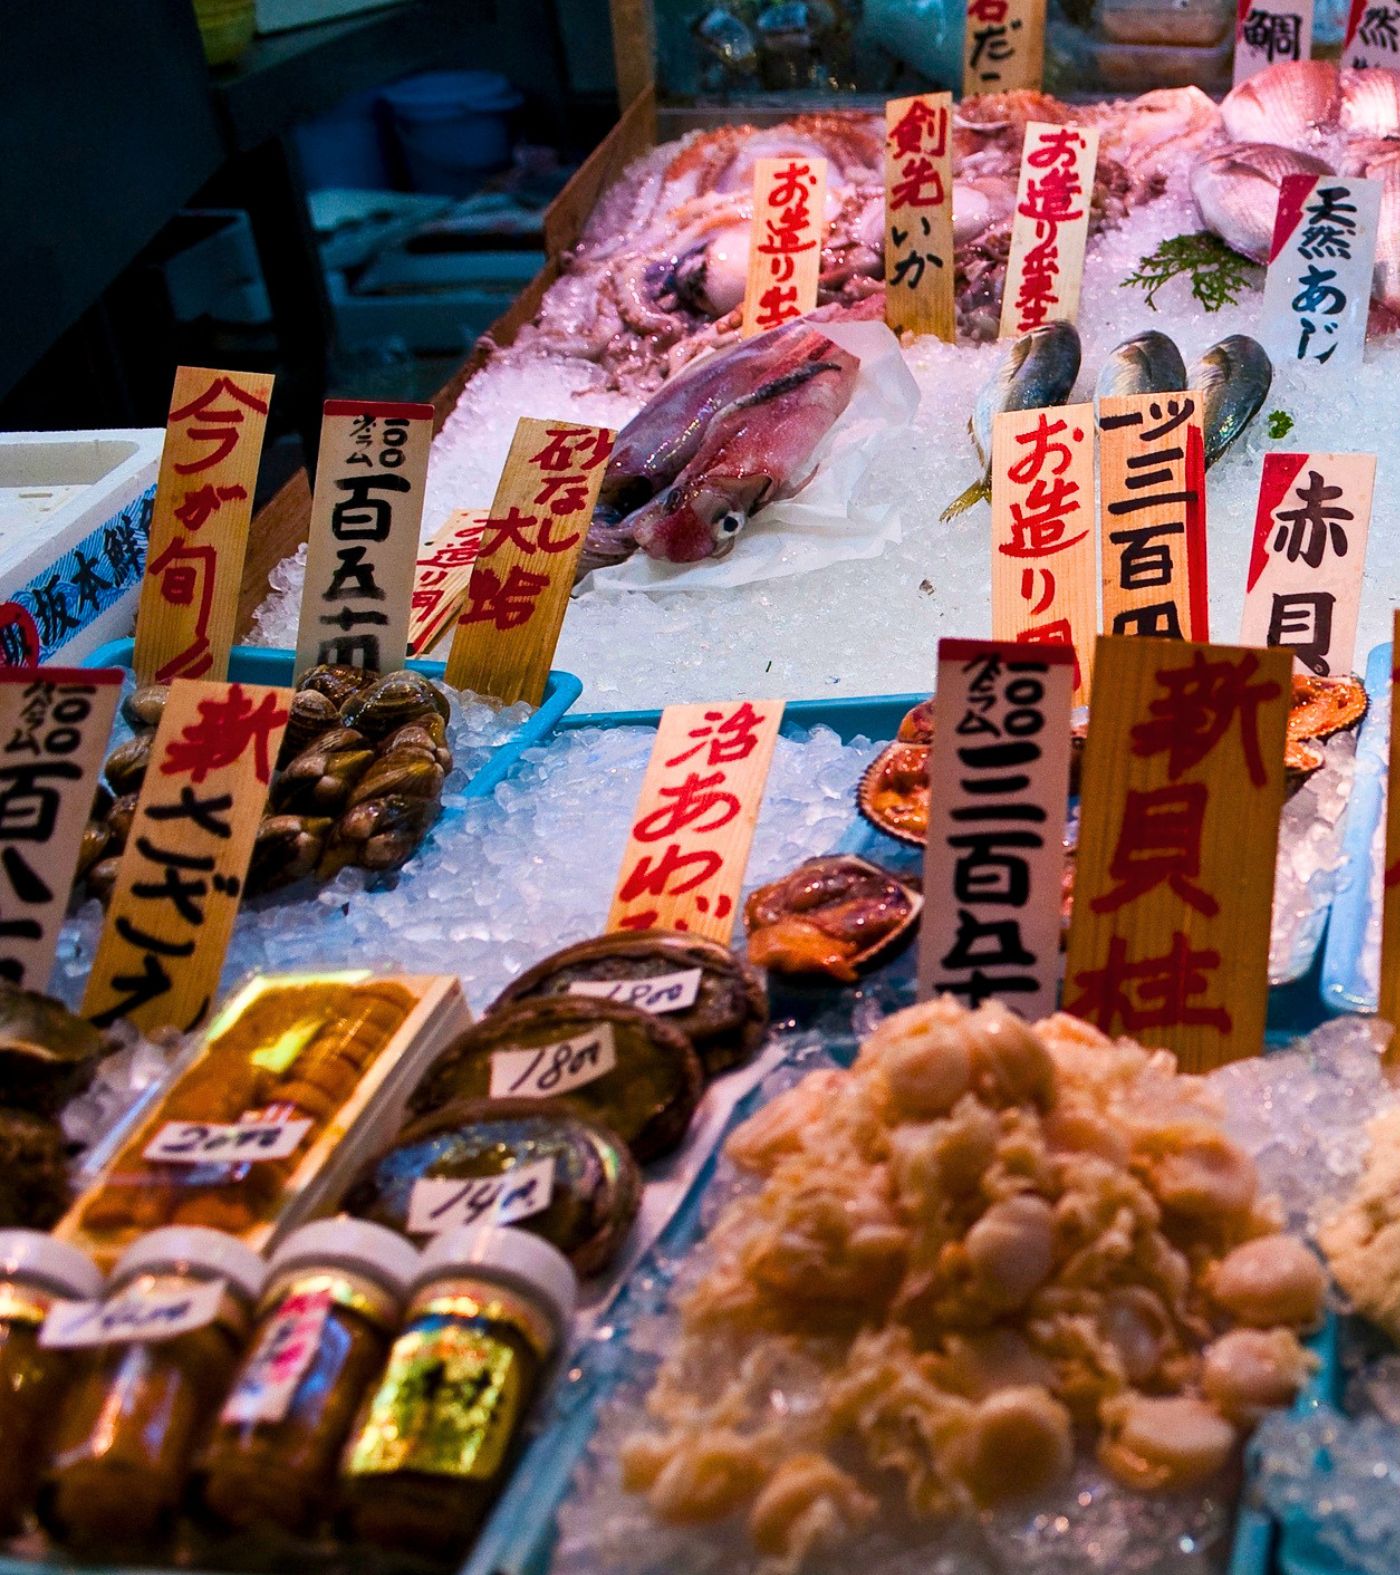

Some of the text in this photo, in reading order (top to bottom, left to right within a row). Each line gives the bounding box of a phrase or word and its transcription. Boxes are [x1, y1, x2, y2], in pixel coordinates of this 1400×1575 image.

[889, 99, 946, 289] 剣先いか
[1292, 186, 1357, 364] 天然あじ
[34, 498, 155, 646] 坂本鮮
[1268, 470, 1355, 677] 赤貝
[0, 761, 84, 985] 百八
